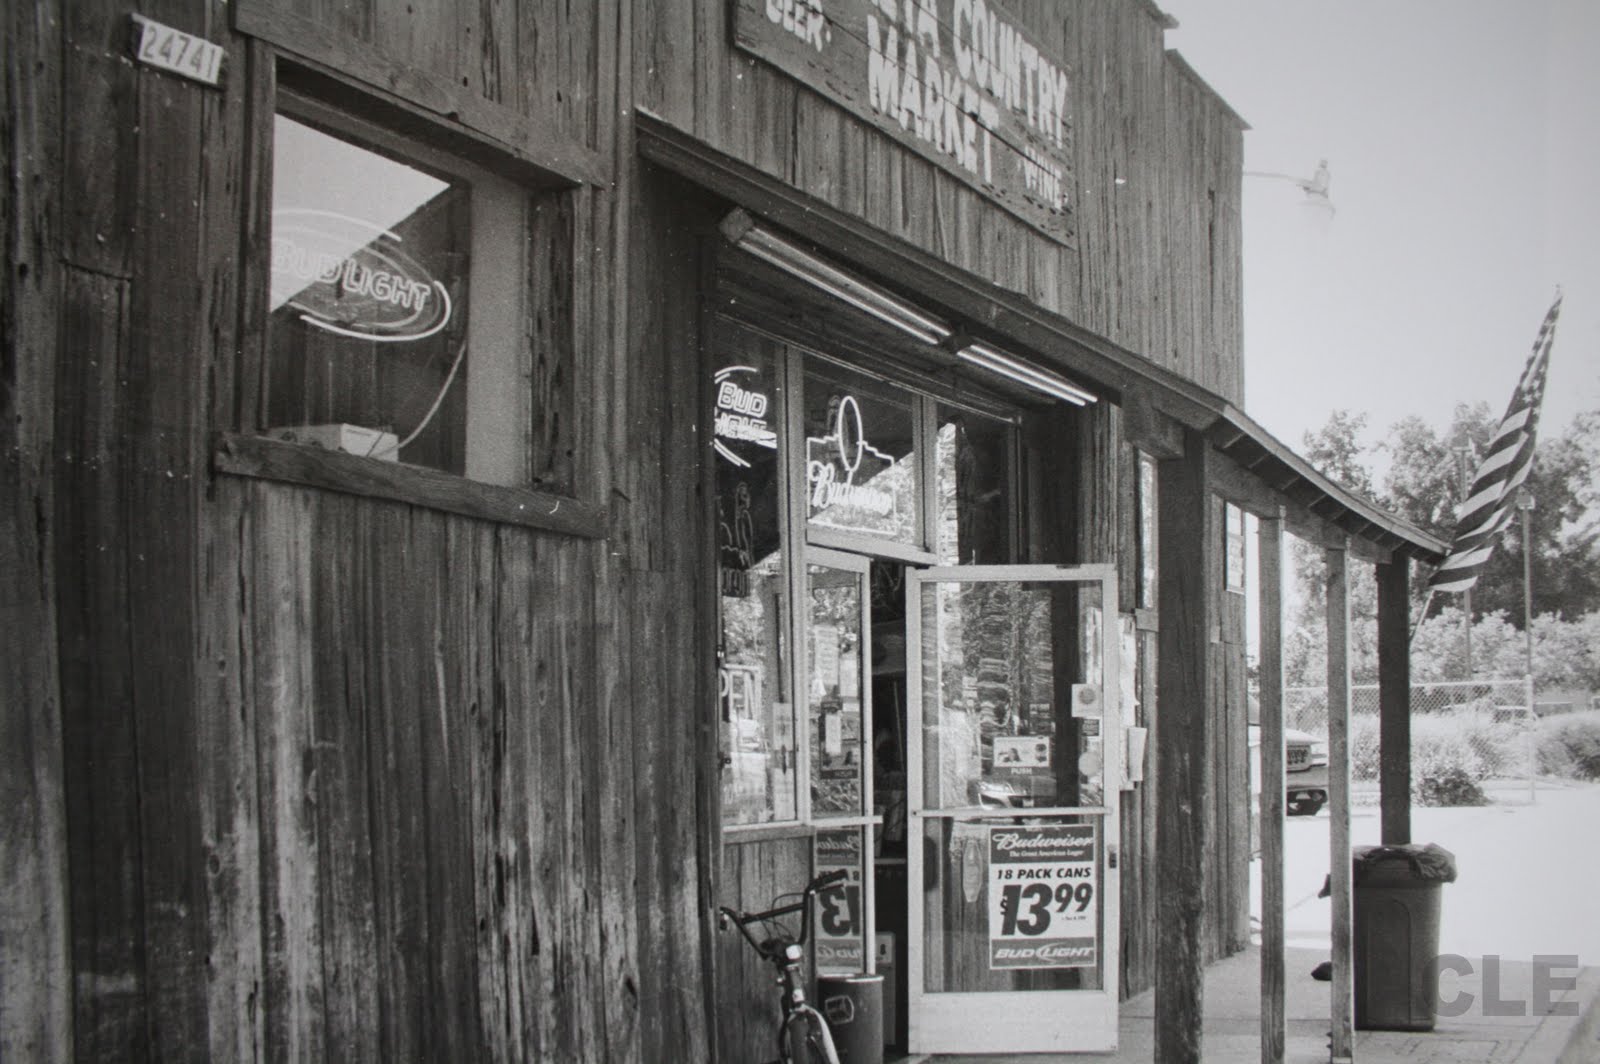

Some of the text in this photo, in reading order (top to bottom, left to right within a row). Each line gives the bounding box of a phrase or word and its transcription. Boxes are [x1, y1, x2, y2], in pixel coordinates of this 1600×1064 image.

[142, 24, 216, 80] 24741
[953, 0, 1067, 149] COUNTRY
[867, 14, 999, 184] MARKET
[342, 258, 431, 312] LIGHT
[717, 381, 767, 418] BUD
[992, 833, 1095, 850] Budweiser
[997, 867, 1092, 880] 18 PACK CANS
[994, 946, 1094, 959] BUD LIGHT
